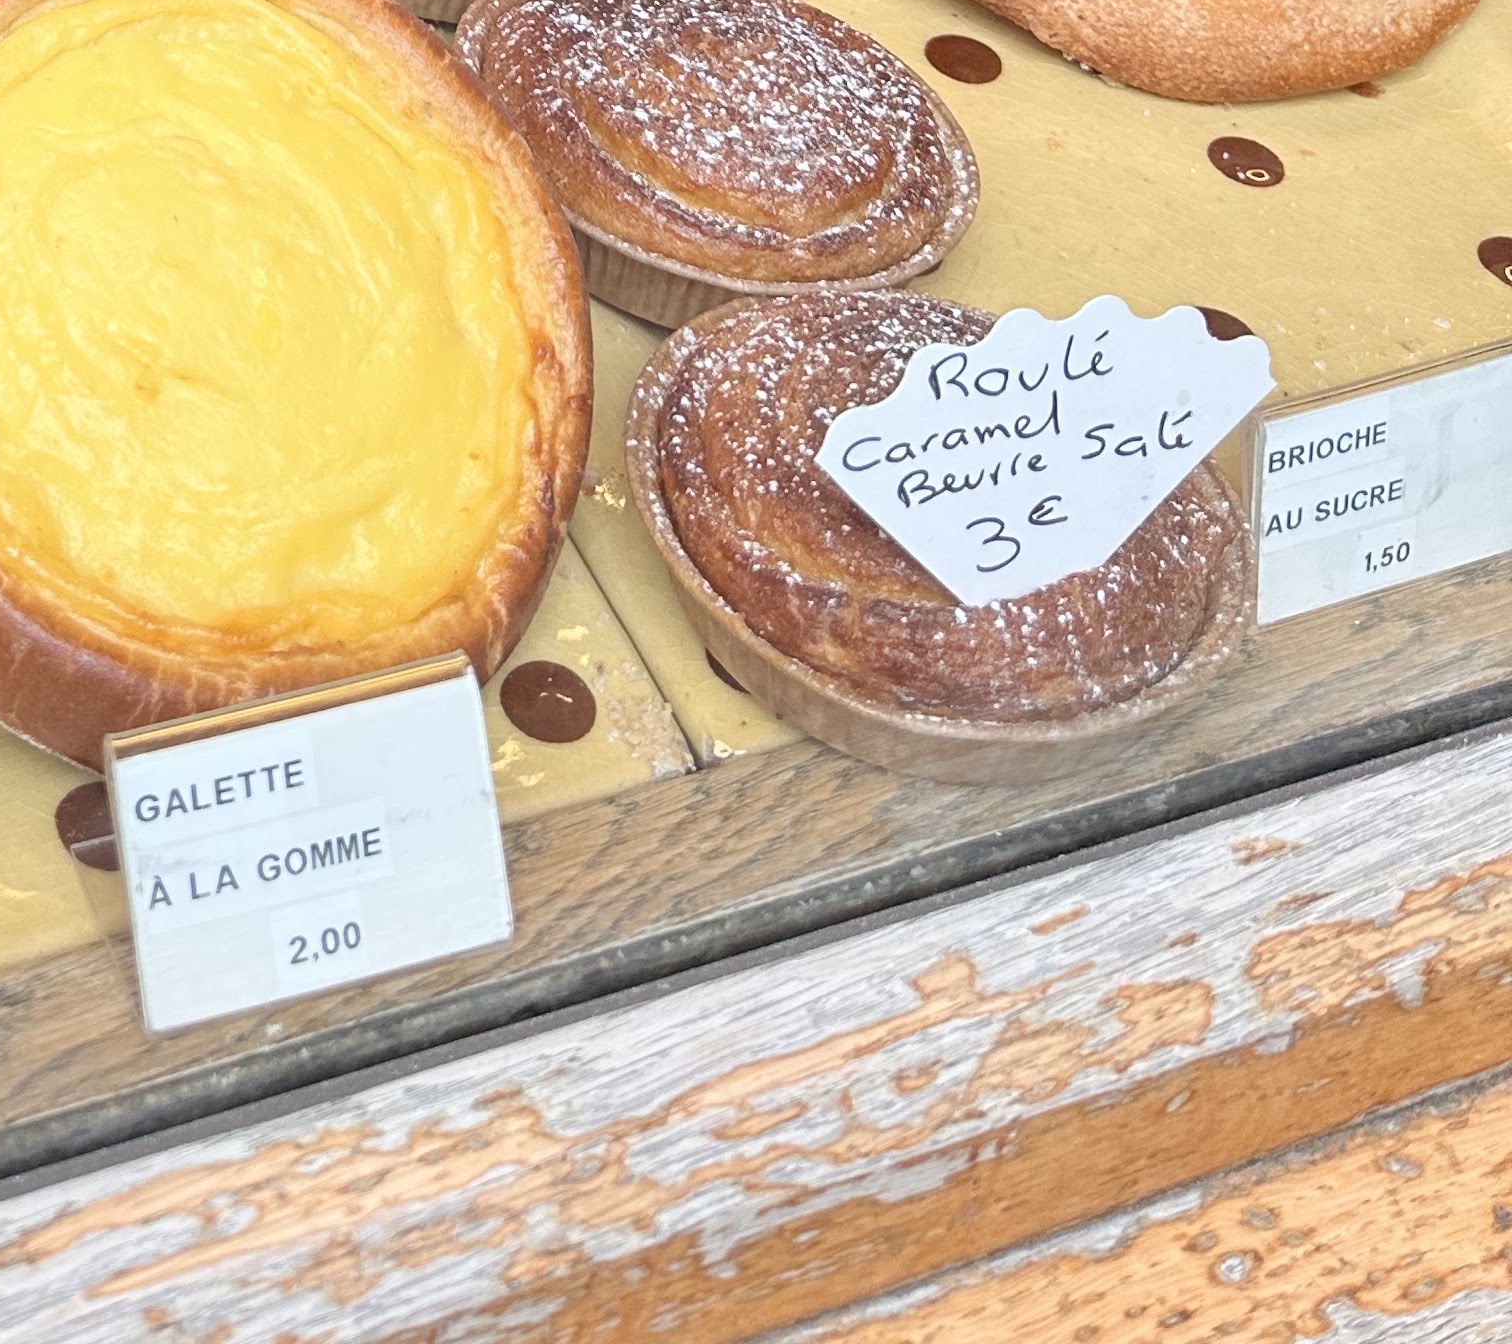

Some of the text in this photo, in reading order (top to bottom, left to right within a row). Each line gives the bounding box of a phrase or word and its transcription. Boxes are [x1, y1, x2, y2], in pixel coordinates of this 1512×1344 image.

[928, 330, 1115, 400] Roulé
[841, 391, 1062, 472] Caramel
[1081, 409, 1195, 461] Salé
[1267, 421, 1388, 475] BRIOCHE
[1264, 478, 1404, 538] AU SUCRE
[1362, 541, 1412, 575] 1,50
[134, 759, 305, 823] GALETTE
[148, 827, 383, 910] À LA GOMME
[289, 920, 362, 965] 2,00
